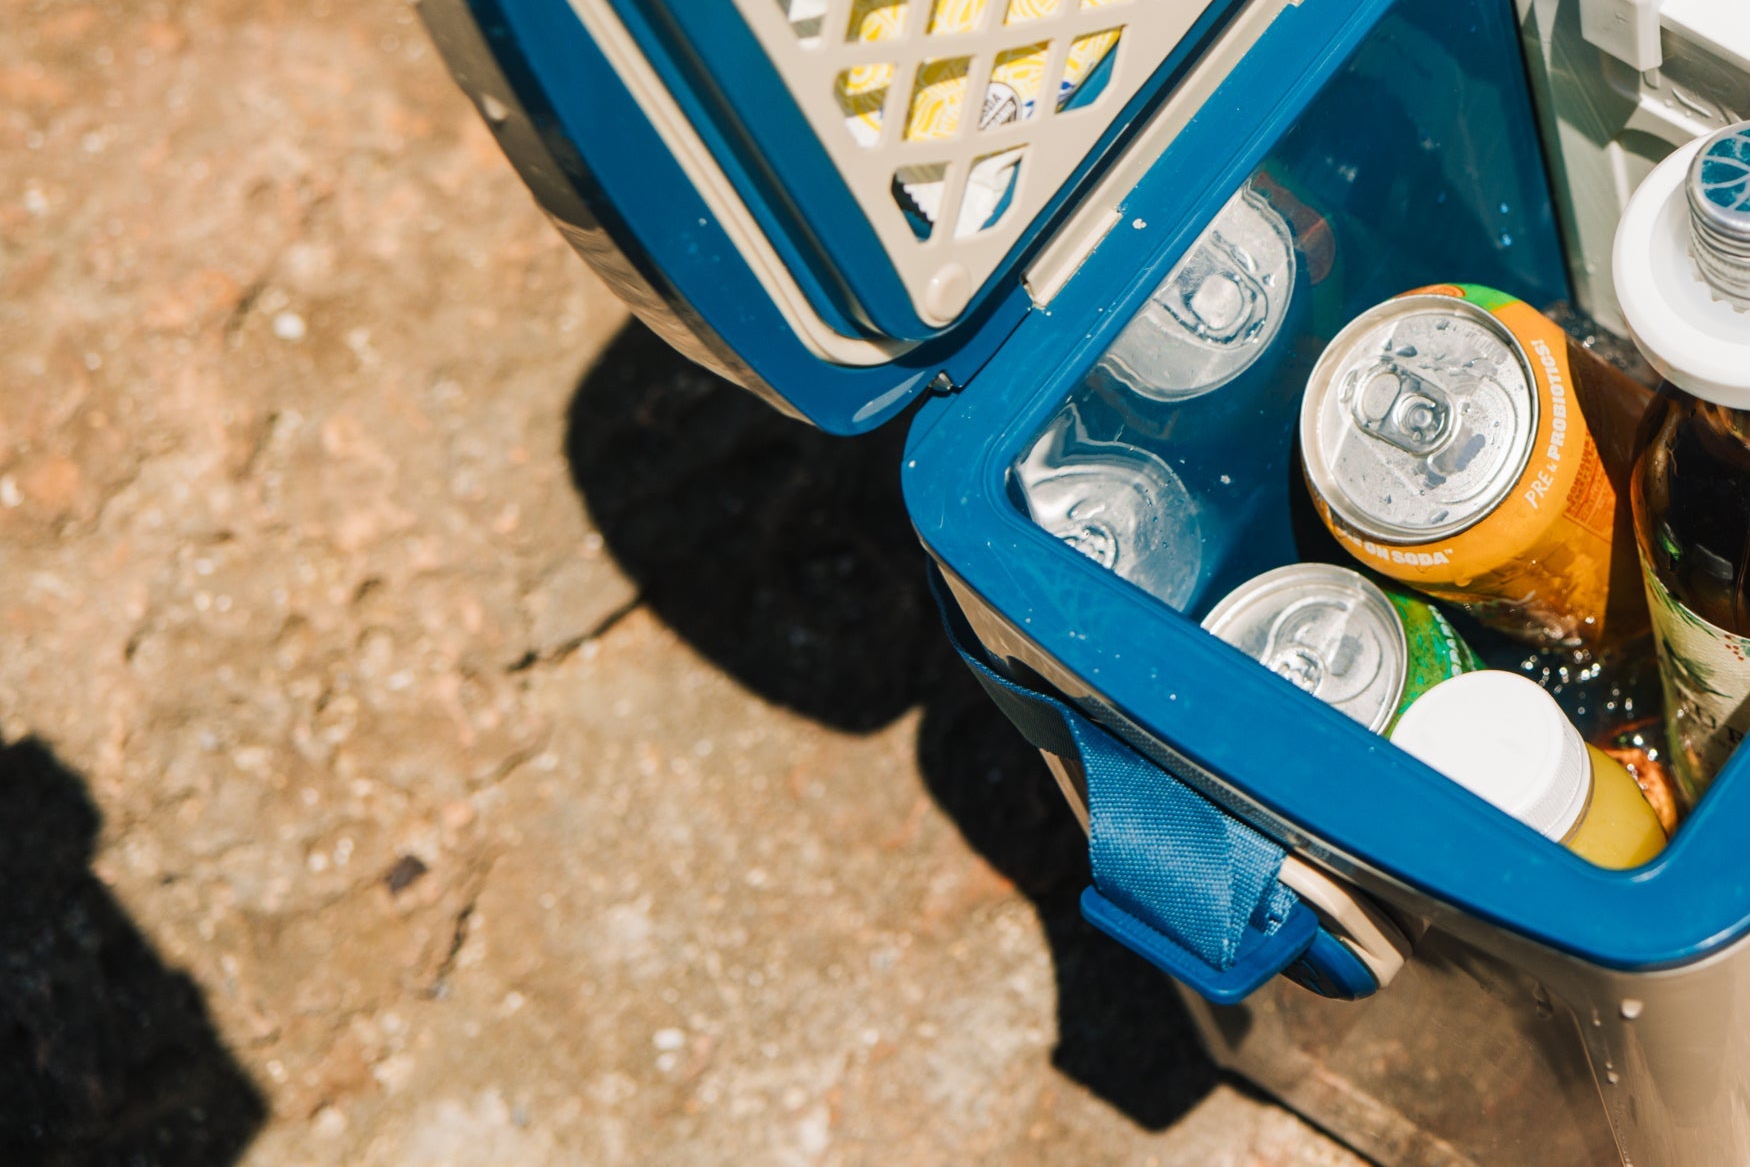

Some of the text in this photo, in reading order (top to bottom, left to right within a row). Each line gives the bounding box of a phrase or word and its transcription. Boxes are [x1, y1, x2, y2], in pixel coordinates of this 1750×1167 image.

[1524, 339, 1567, 510] PRE & PROBIOTICS!
[1364, 541, 1389, 560] ON
